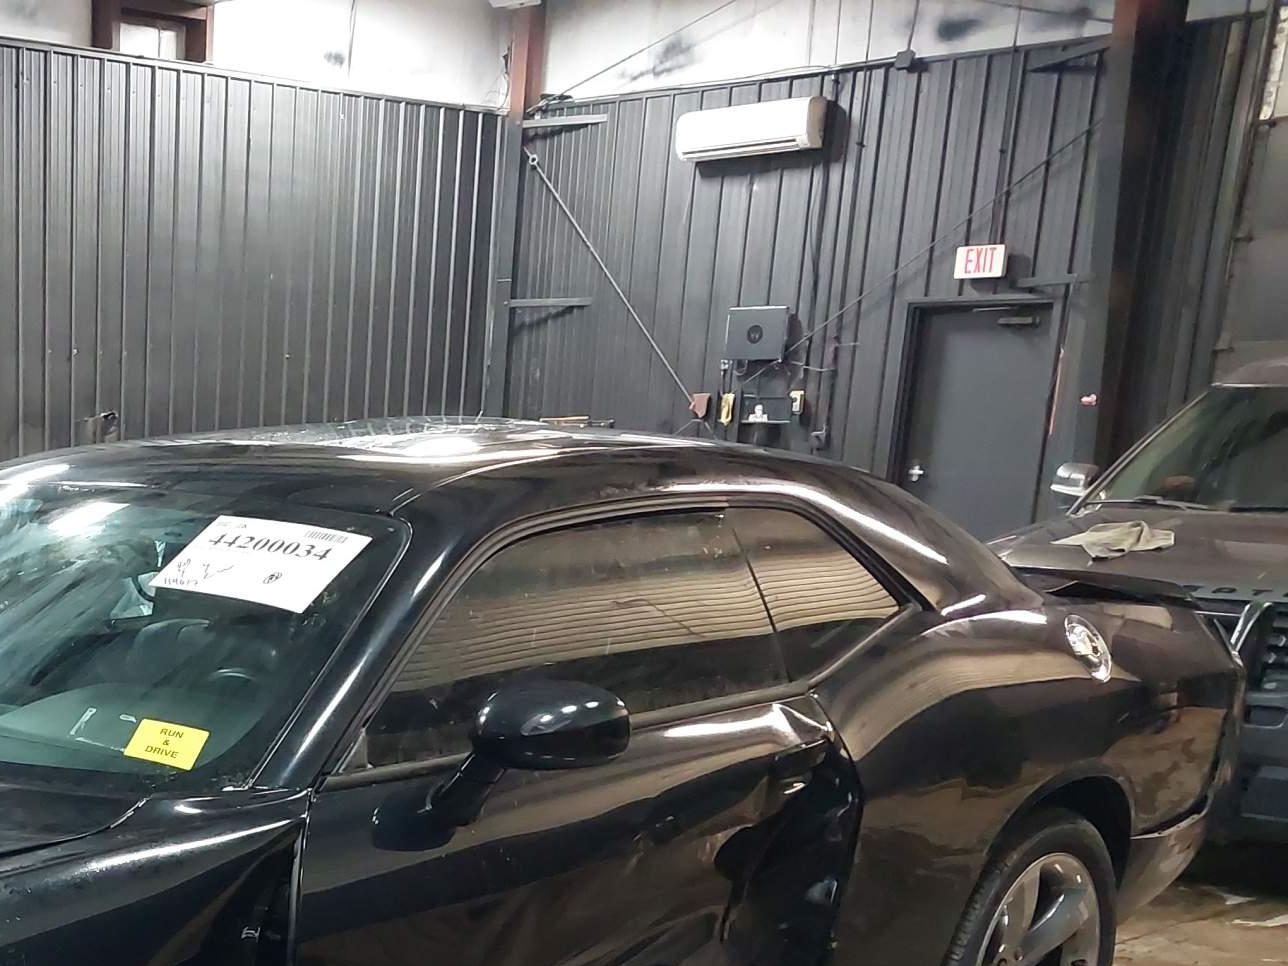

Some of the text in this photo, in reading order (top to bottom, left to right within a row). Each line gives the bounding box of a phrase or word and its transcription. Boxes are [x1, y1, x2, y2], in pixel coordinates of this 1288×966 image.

[964, 247, 997, 274] EXIT
[208, 533, 332, 560] 44200034
[160, 728, 184, 738] RUN
[145, 745, 179, 759] DRIVE
